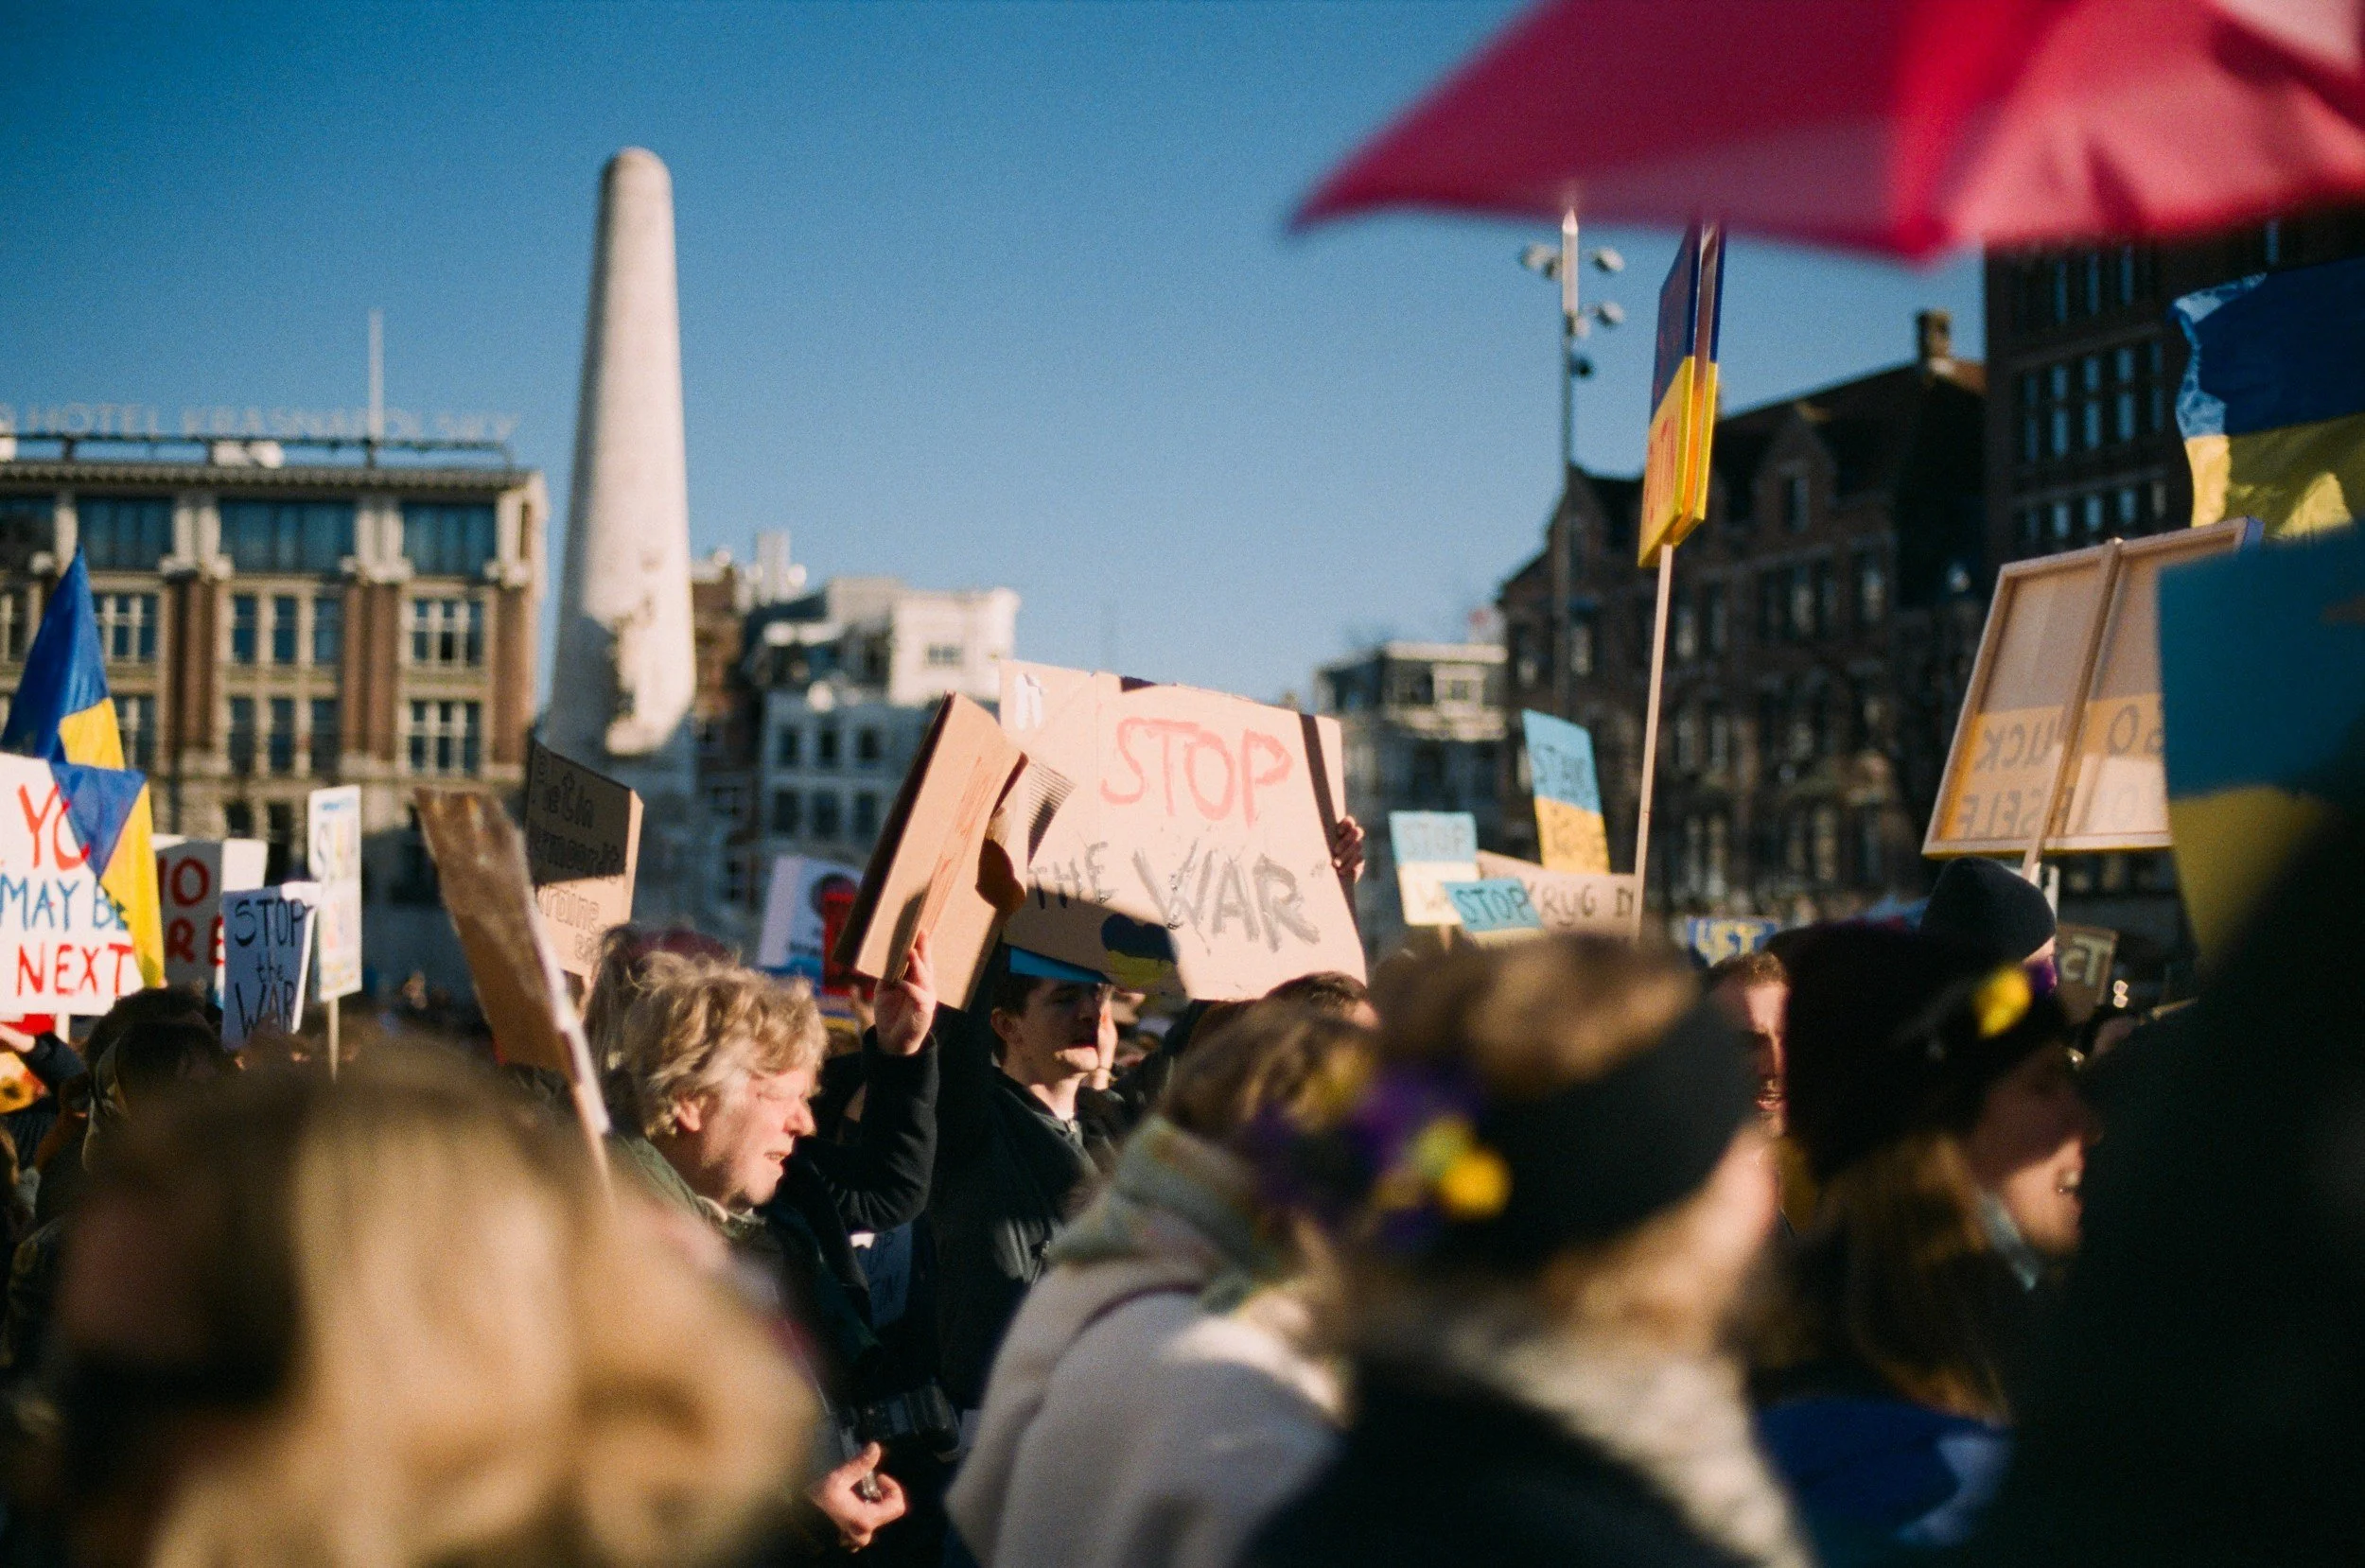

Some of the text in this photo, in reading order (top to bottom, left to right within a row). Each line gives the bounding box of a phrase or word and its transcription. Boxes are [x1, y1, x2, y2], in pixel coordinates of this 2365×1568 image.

[26, 403, 161, 436] HOTEL
[1101, 717, 1293, 828] STOP
[0, 872, 79, 932] MAY
[235, 899, 305, 947] STOP
[1027, 837, 1321, 957] THE WAR
[1456, 886, 1530, 924] STOP
[17, 943, 133, 996] NEXT
[255, 951, 284, 984] the
[235, 981, 295, 1037] WAR
